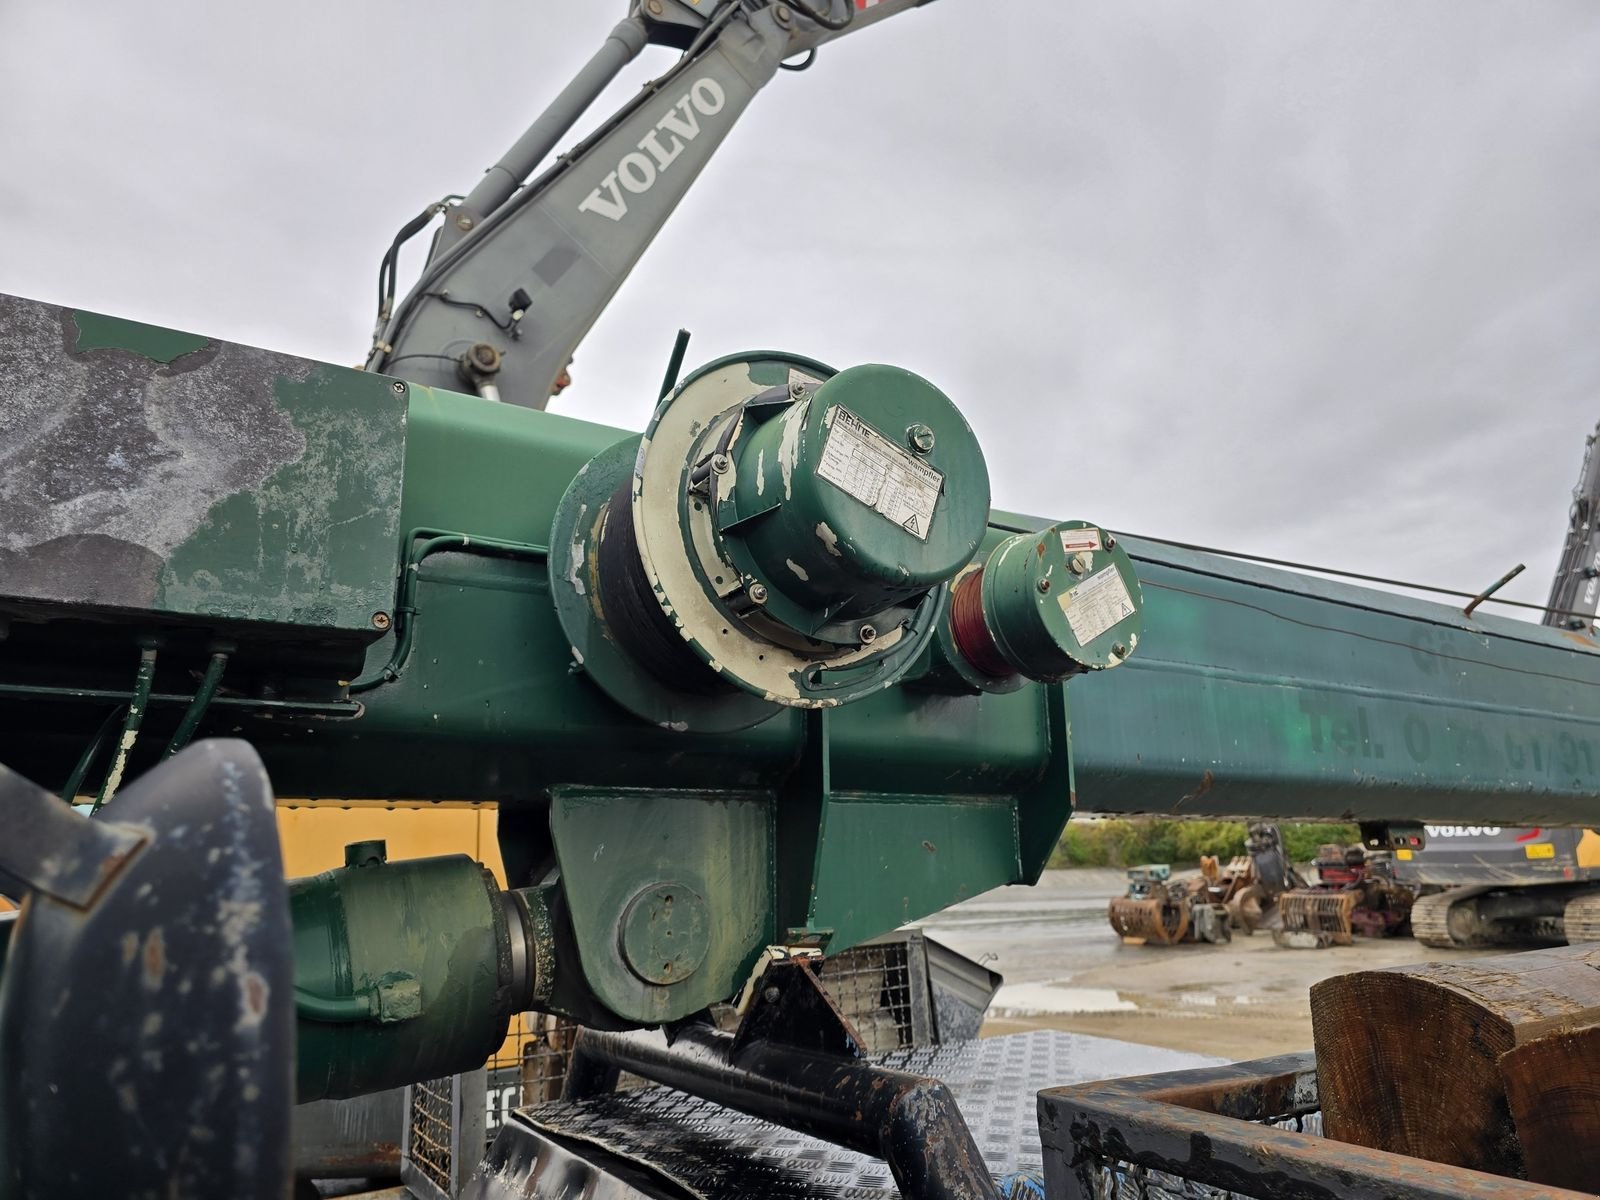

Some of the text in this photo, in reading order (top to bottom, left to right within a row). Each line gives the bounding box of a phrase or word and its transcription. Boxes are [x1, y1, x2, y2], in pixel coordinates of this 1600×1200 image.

[578, 78, 725, 221] VOLVO
[1299, 694, 1384, 759] Tel.
[486, 1085, 524, 1128] EC
